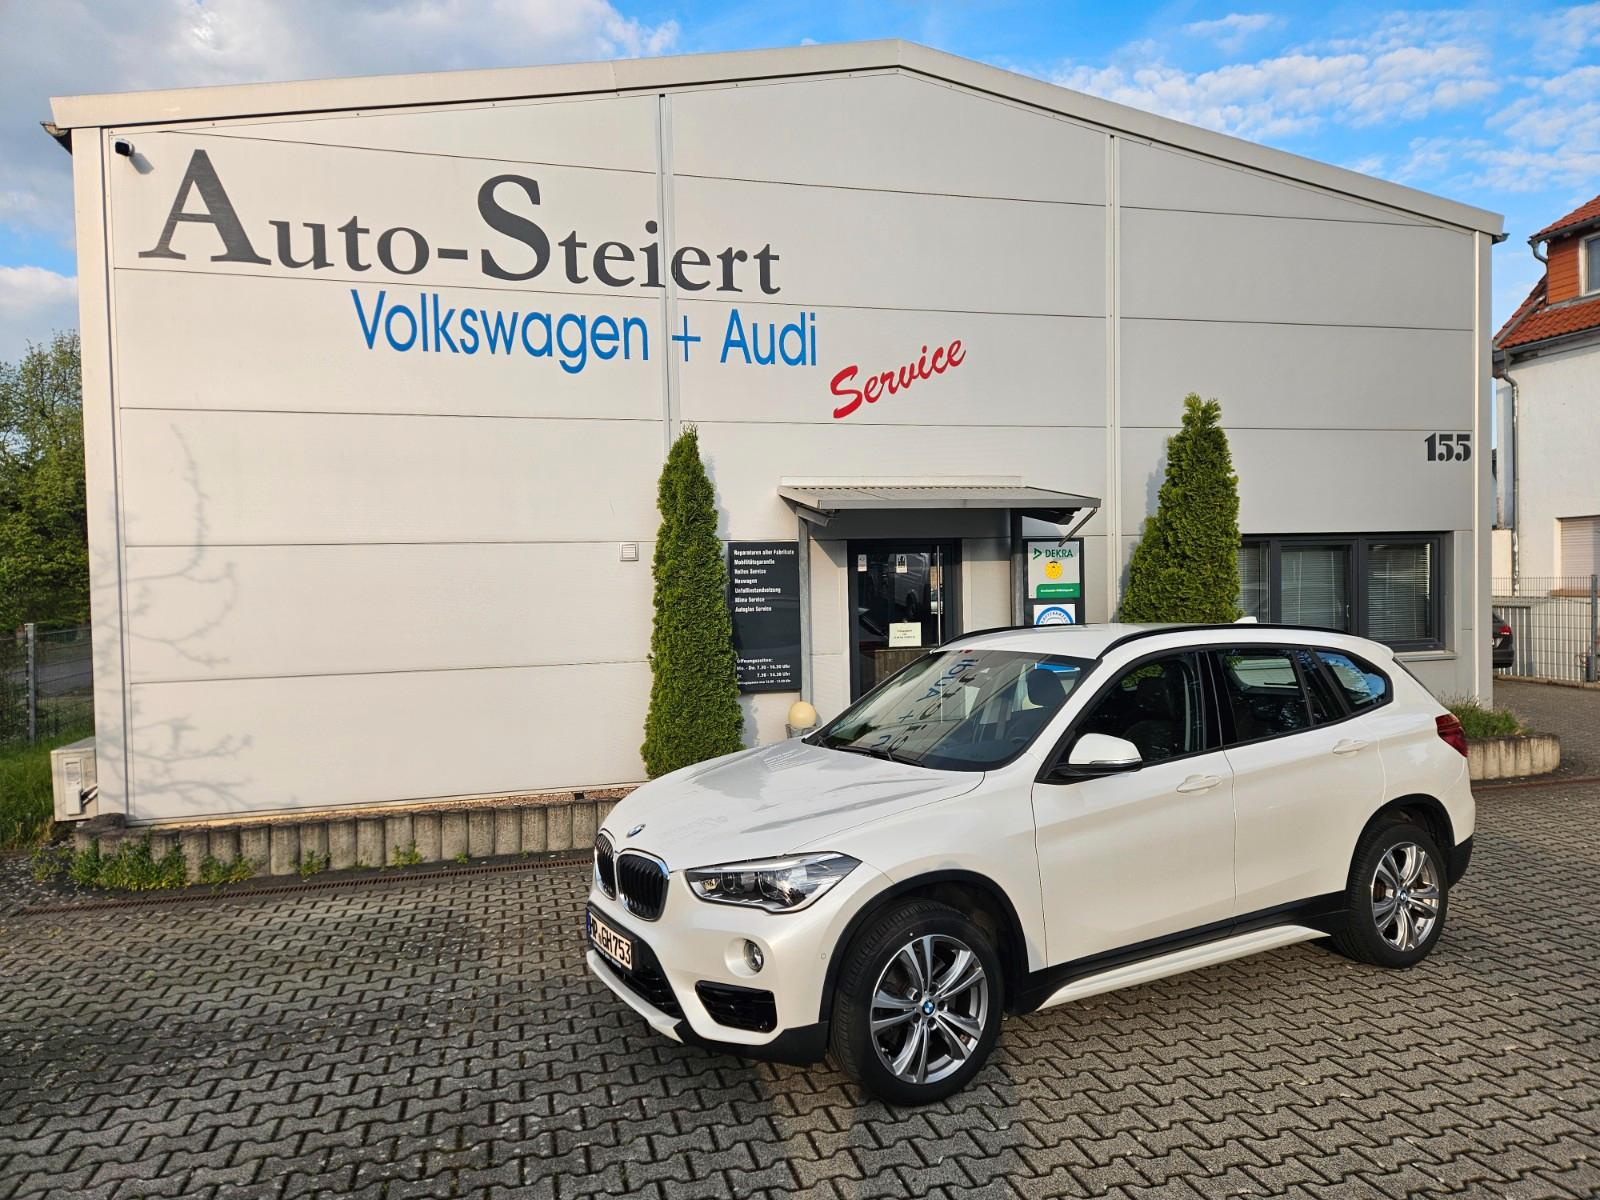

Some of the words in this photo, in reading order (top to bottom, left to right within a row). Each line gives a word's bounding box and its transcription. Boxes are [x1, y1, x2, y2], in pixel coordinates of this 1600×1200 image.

[138, 149, 781, 295] Auto-Steiert
[350, 289, 649, 374] Volkswagen
[720, 309, 817, 366] Audi
[830, 340, 966, 419] Service
[1424, 432, 1472, 462] 155
[1045, 549, 1074, 558] DEKRA
